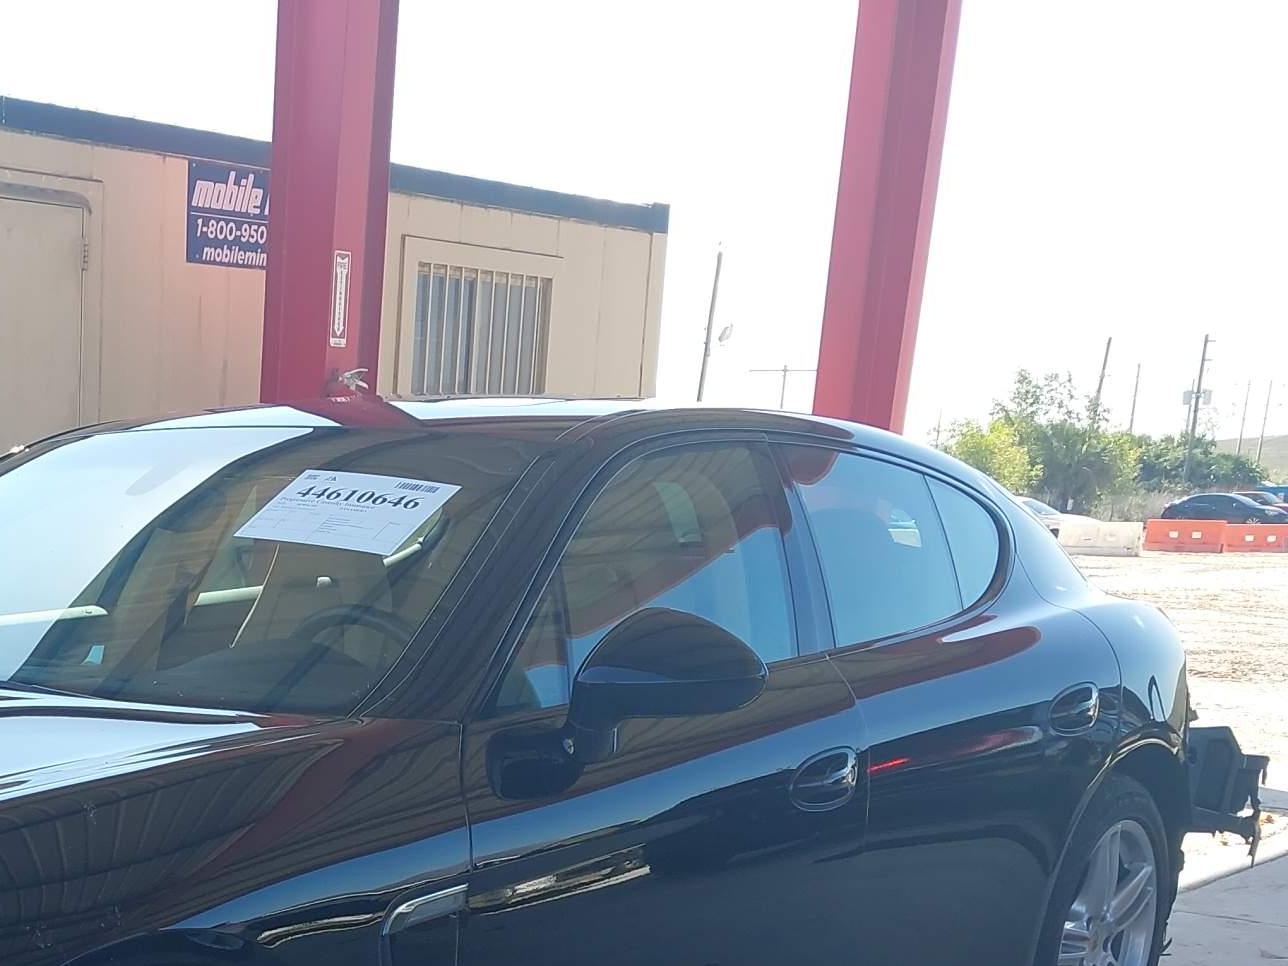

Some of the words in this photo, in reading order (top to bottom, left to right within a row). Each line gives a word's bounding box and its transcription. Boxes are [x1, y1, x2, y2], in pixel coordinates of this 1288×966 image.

[191, 170, 264, 215] mobile
[196, 218, 267, 244] 1-800-950
[296, 485, 424, 510] 44610646
